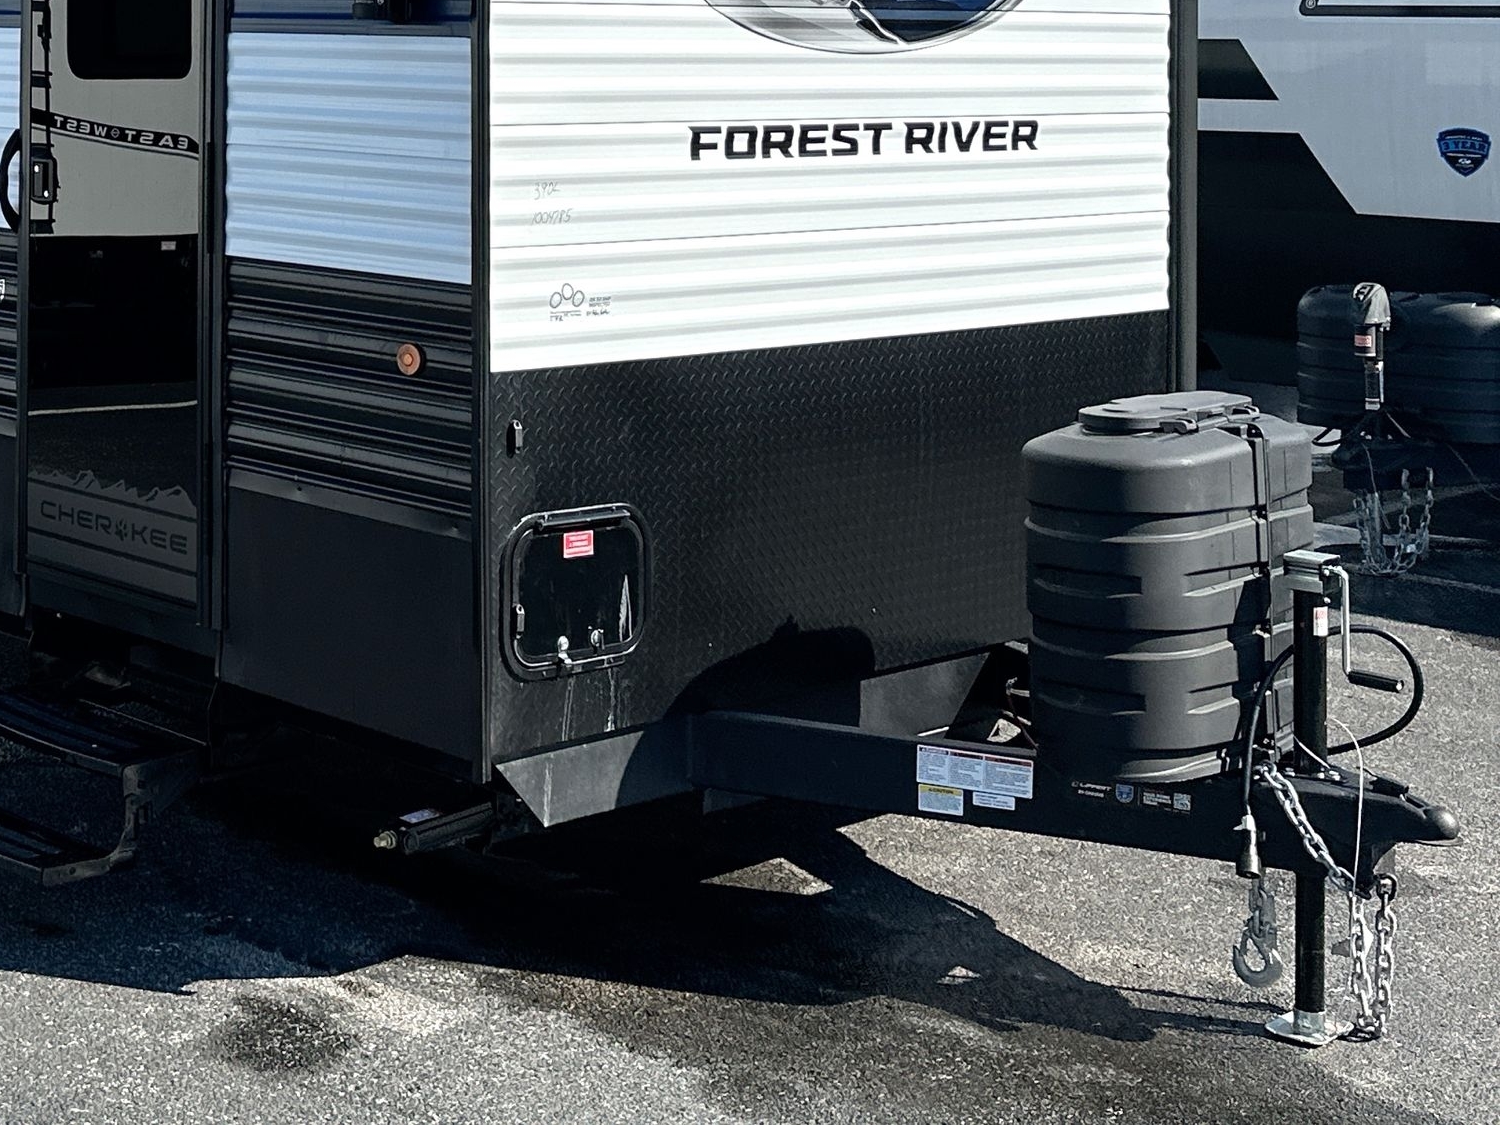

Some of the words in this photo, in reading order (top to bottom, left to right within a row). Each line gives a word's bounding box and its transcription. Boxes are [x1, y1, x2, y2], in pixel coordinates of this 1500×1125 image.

[688, 122, 893, 161] FOREST
[904, 119, 1039, 155] RIVER
[40, 500, 188, 556] CHEROKEE
